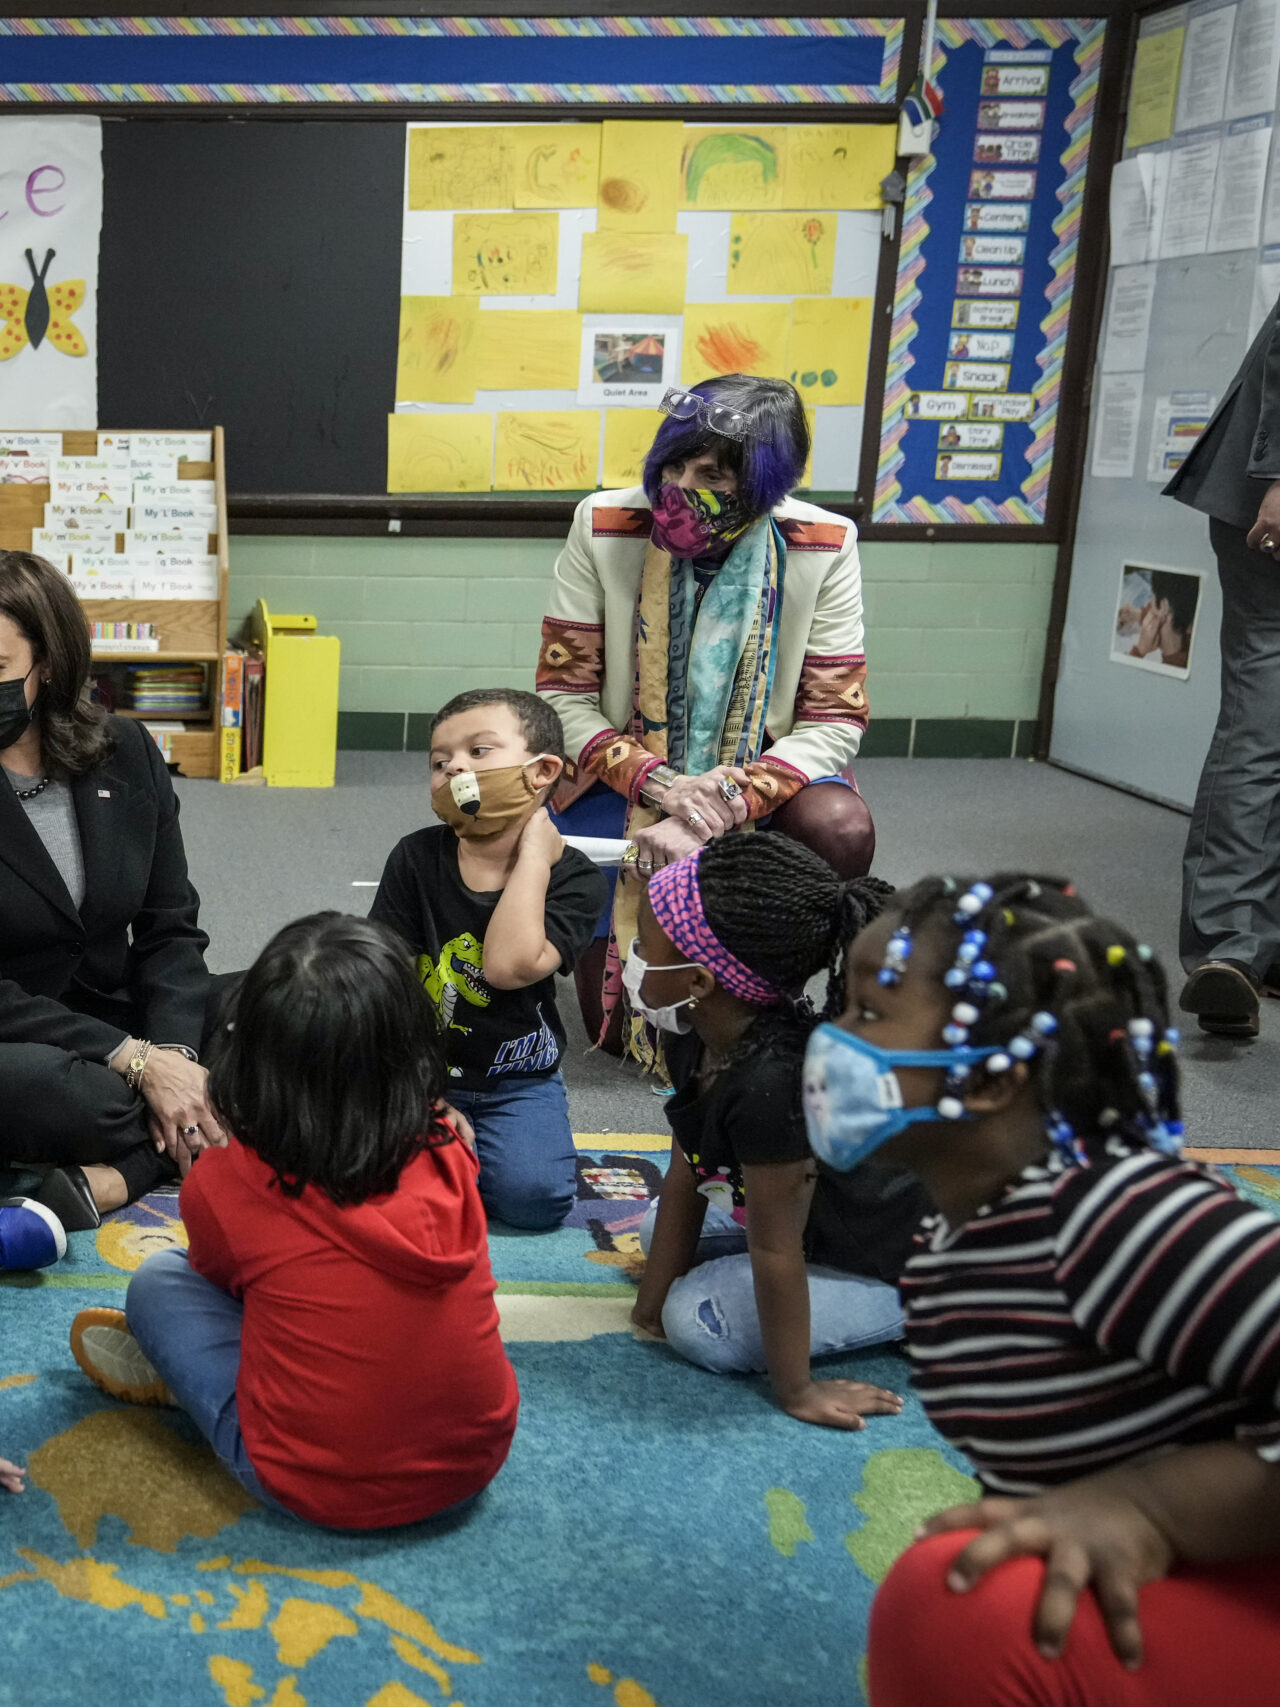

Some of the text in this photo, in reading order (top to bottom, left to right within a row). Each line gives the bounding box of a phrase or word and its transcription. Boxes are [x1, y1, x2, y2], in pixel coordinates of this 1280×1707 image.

[1003, 76, 1042, 86] Arrival
[975, 246, 1017, 255] Clean Up
[983, 277, 1015, 286] Lunch
[963, 371, 998, 381] Snack
[926, 400, 956, 411] Gym
[139, 437, 150, 446] My
[165, 437, 186, 445] Book
[58, 461, 70, 470] My
[130, 460, 152, 468] Book
[58, 482, 71, 492] My
[87, 482, 109, 491] Book
[143, 486, 156, 495] My
[52, 505, 64, 515] My
[80, 505, 103, 514] Book
[144, 509, 158, 518] My
[172, 509, 194, 517] Book
[40, 533, 53, 541] My
[135, 533, 147, 542] My
[161, 533, 183, 541] Book
[83, 558, 95, 566] My
[74, 581, 86, 590] My
[101, 581, 123, 589] Book
[142, 582, 155, 591] My
[170, 582, 192, 590] Book
[494, 1031, 537, 1064] I'M
